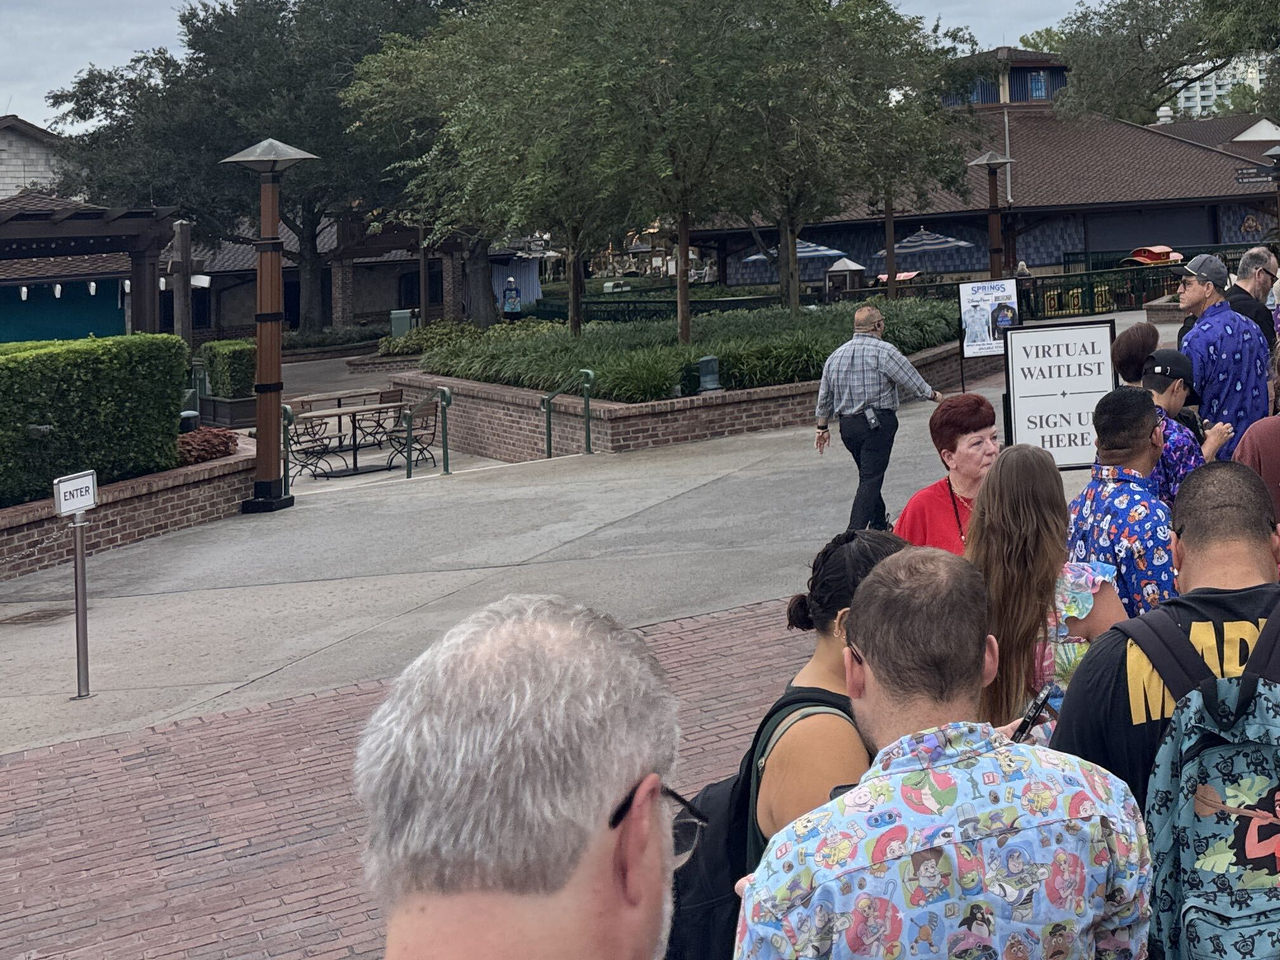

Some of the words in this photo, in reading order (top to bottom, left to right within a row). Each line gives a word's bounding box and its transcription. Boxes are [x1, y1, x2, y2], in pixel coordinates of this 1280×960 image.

[971, 283, 1006, 295] SPRINGS
[1022, 341, 1102, 360] VIRTUAL
[1020, 361, 1105, 381] WAITLIST
[1026, 412, 1072, 430] SIGN
[1077, 411, 1095, 427] U
[1041, 432, 1092, 449] HERE
[63, 485, 91, 501] ENTER
